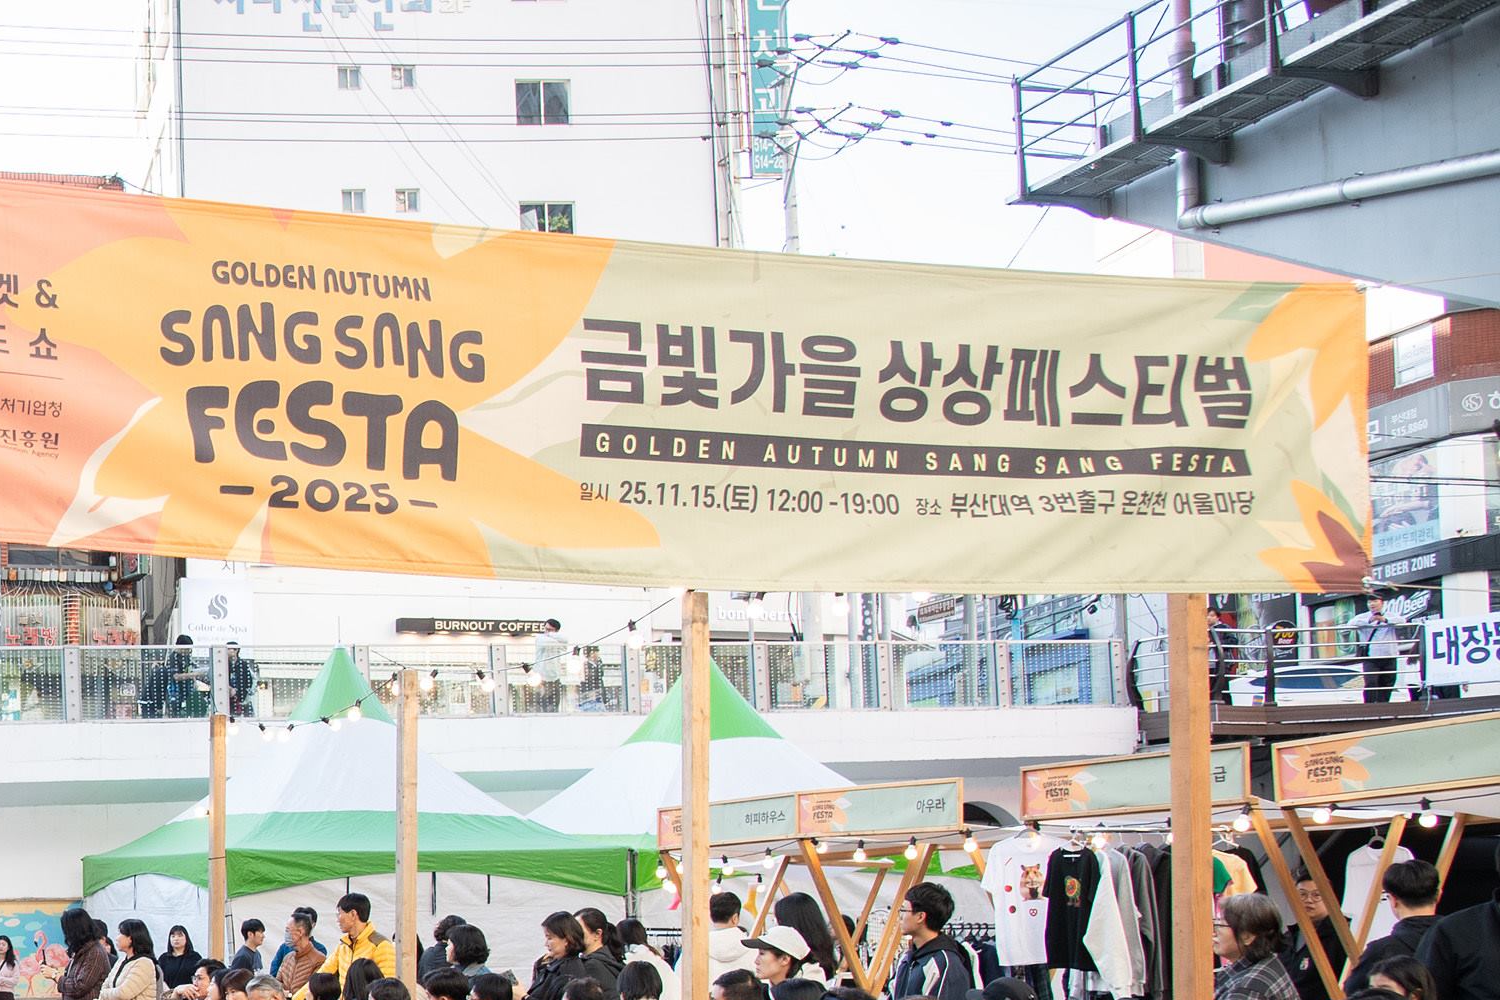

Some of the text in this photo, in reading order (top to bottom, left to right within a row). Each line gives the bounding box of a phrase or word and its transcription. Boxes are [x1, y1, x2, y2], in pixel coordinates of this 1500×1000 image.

[211, 260, 432, 302] GOLDEN AUTUMN
[34, 279, 60, 310] &
[159, 301, 486, 383] SANG SANG
[185, 379, 460, 482] FESTA
[31, 450, 60, 460] Agency
[595, 432, 1237, 475] GOLDEN AUTUMN SANG SANG FESTA
[268, 474, 399, 515] 2025
[580, 481, 610, 502] 일시
[619, 480, 759, 513] 25.11.15.(토)
[915, 497, 942, 517] 장소
[950, 492, 1034, 519] 부산대역
[1038, 490, 1116, 515] 3번출구
[1121, 490, 1167, 517] 온천천
[1173, 490, 1255, 517] 어울마당
[1384, 561, 1409, 577] BEER
[1411, 553, 1437, 571] ZONE
[188, 624, 215, 633] Color
[229, 623, 248, 634] Spa
[434, 620, 546, 632] BURNOUT COFFEE
[1307, 766, 1342, 779] FESTA
[916, 797, 946, 814] 아우라
[1046, 788, 1070, 799] FESTA
[744, 811, 786, 825] 히피하우스
